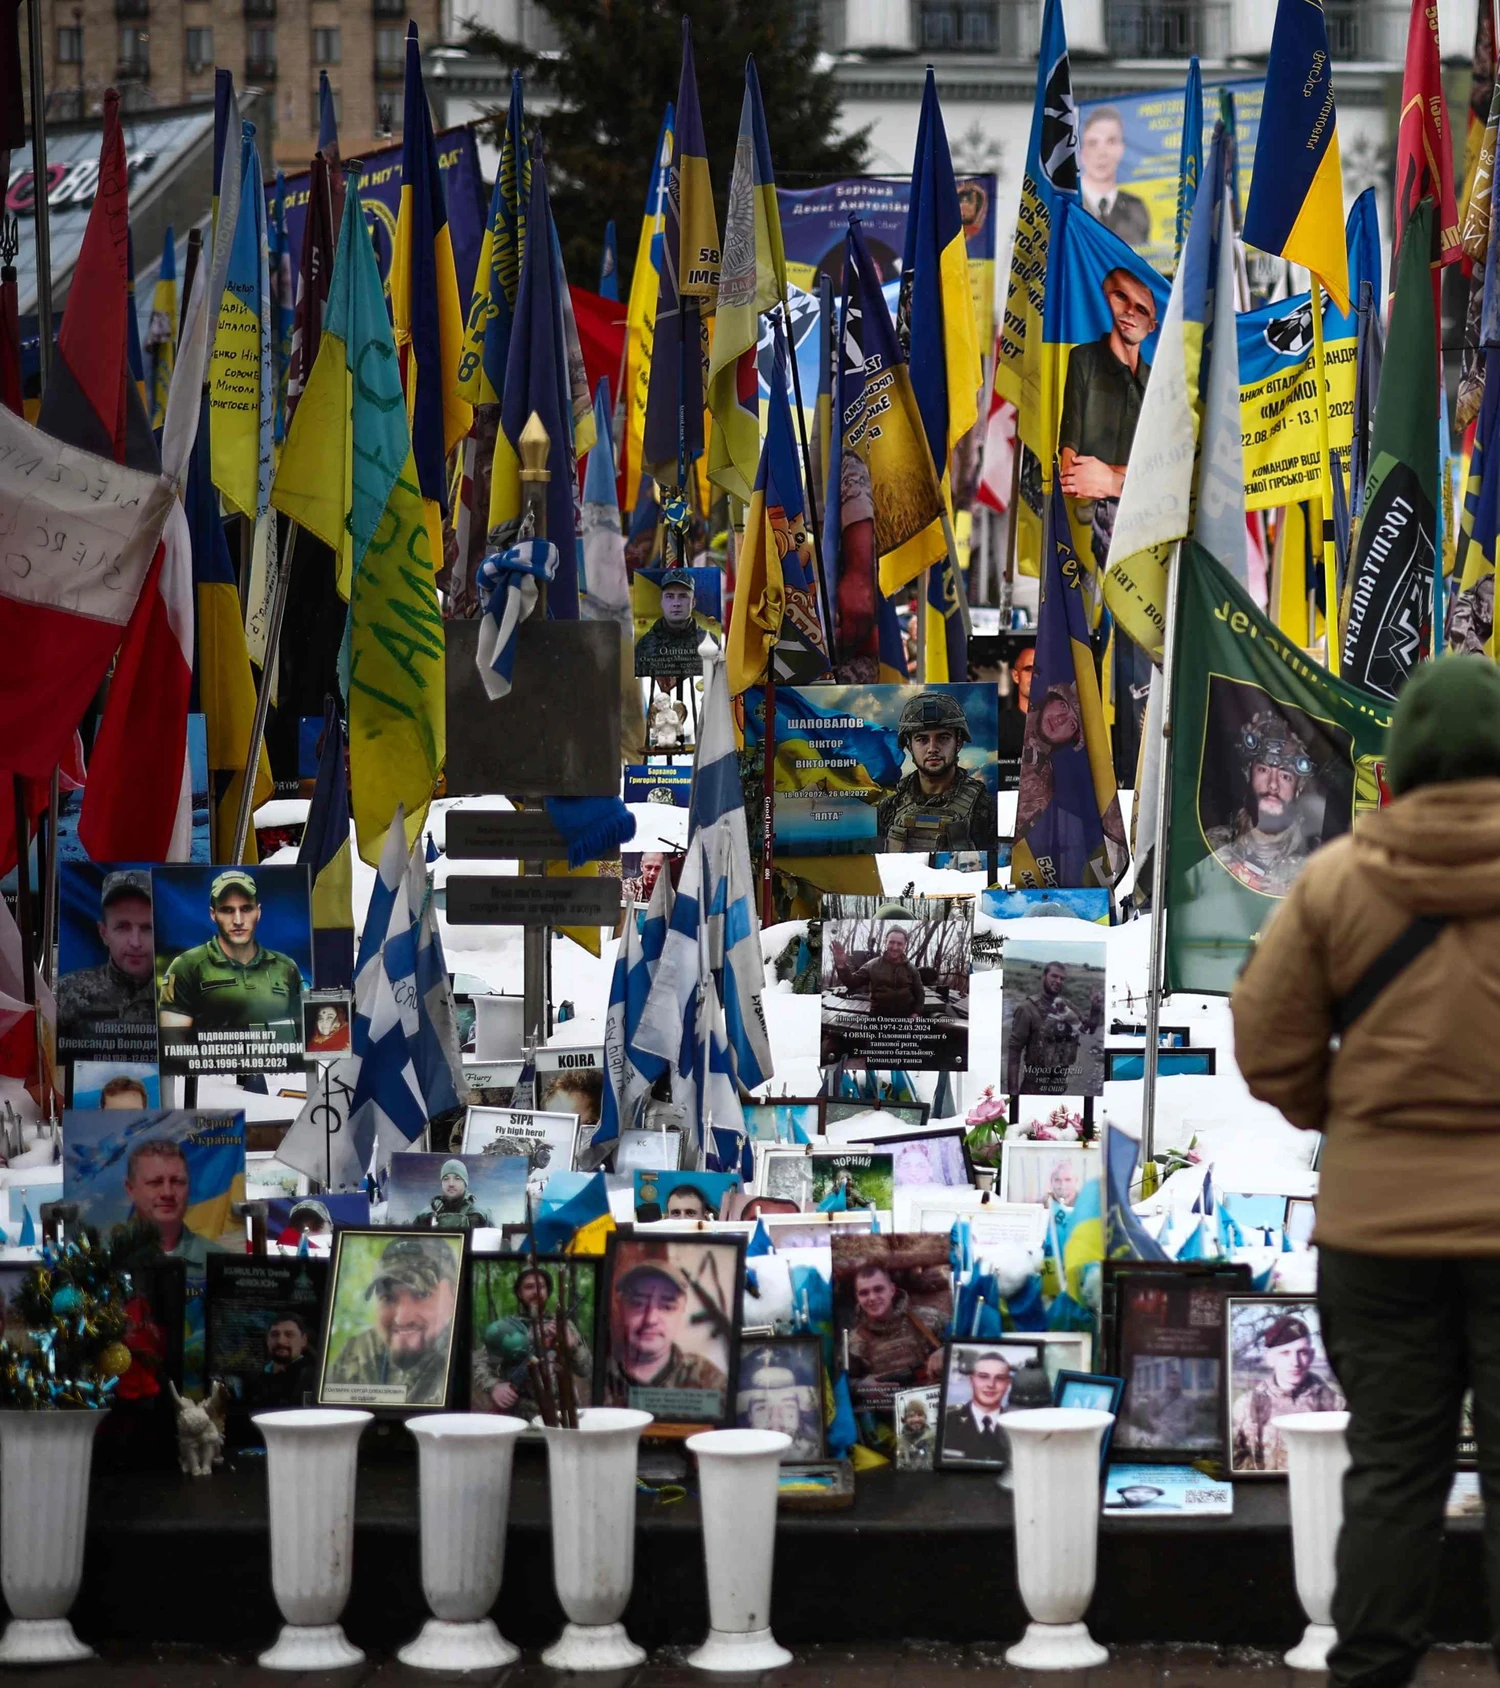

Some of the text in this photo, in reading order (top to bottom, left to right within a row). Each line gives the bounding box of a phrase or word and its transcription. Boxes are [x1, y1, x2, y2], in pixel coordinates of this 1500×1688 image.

[698, 247, 719, 265] 58
[1296, 401, 1355, 426] 13.1.2022
[1251, 457, 1299, 478] КОМАНДИР
[788, 717, 864, 730] ШАПОВАЛОВ
[808, 740, 844, 750] ВІКТОР
[796, 758, 857, 769] ВІКТОРОВИЧ
[878, 1015, 915, 1025] Олександр
[916, 1015, 954, 1025] Вікторович
[198, 1030, 277, 1042] ПІДПОЛКОВНИК НГУ
[878, 1032, 912, 1040] Головний
[912, 1033, 941, 1041] сержант
[58, 1037, 116, 1052] Олександр
[164, 1044, 200, 1056] ГАНЖА
[201, 1041, 245, 1056] ОЛЕКСІЙ
[188, 1056, 288, 1071] 09.03.1996-14.09.2024
[558, 1053, 596, 1069] KOIRA
[867, 1056, 902, 1065] Командир
[1023, 1065, 1083, 1077] Мороз Сергій
[195, 1116, 235, 1131] Герой
[510, 1113, 534, 1127] SIPA
[495, 1125, 546, 1138] Fly high hero!
[187, 1132, 242, 1148] України
[833, 1156, 872, 1167] ЧОРНИЙ
